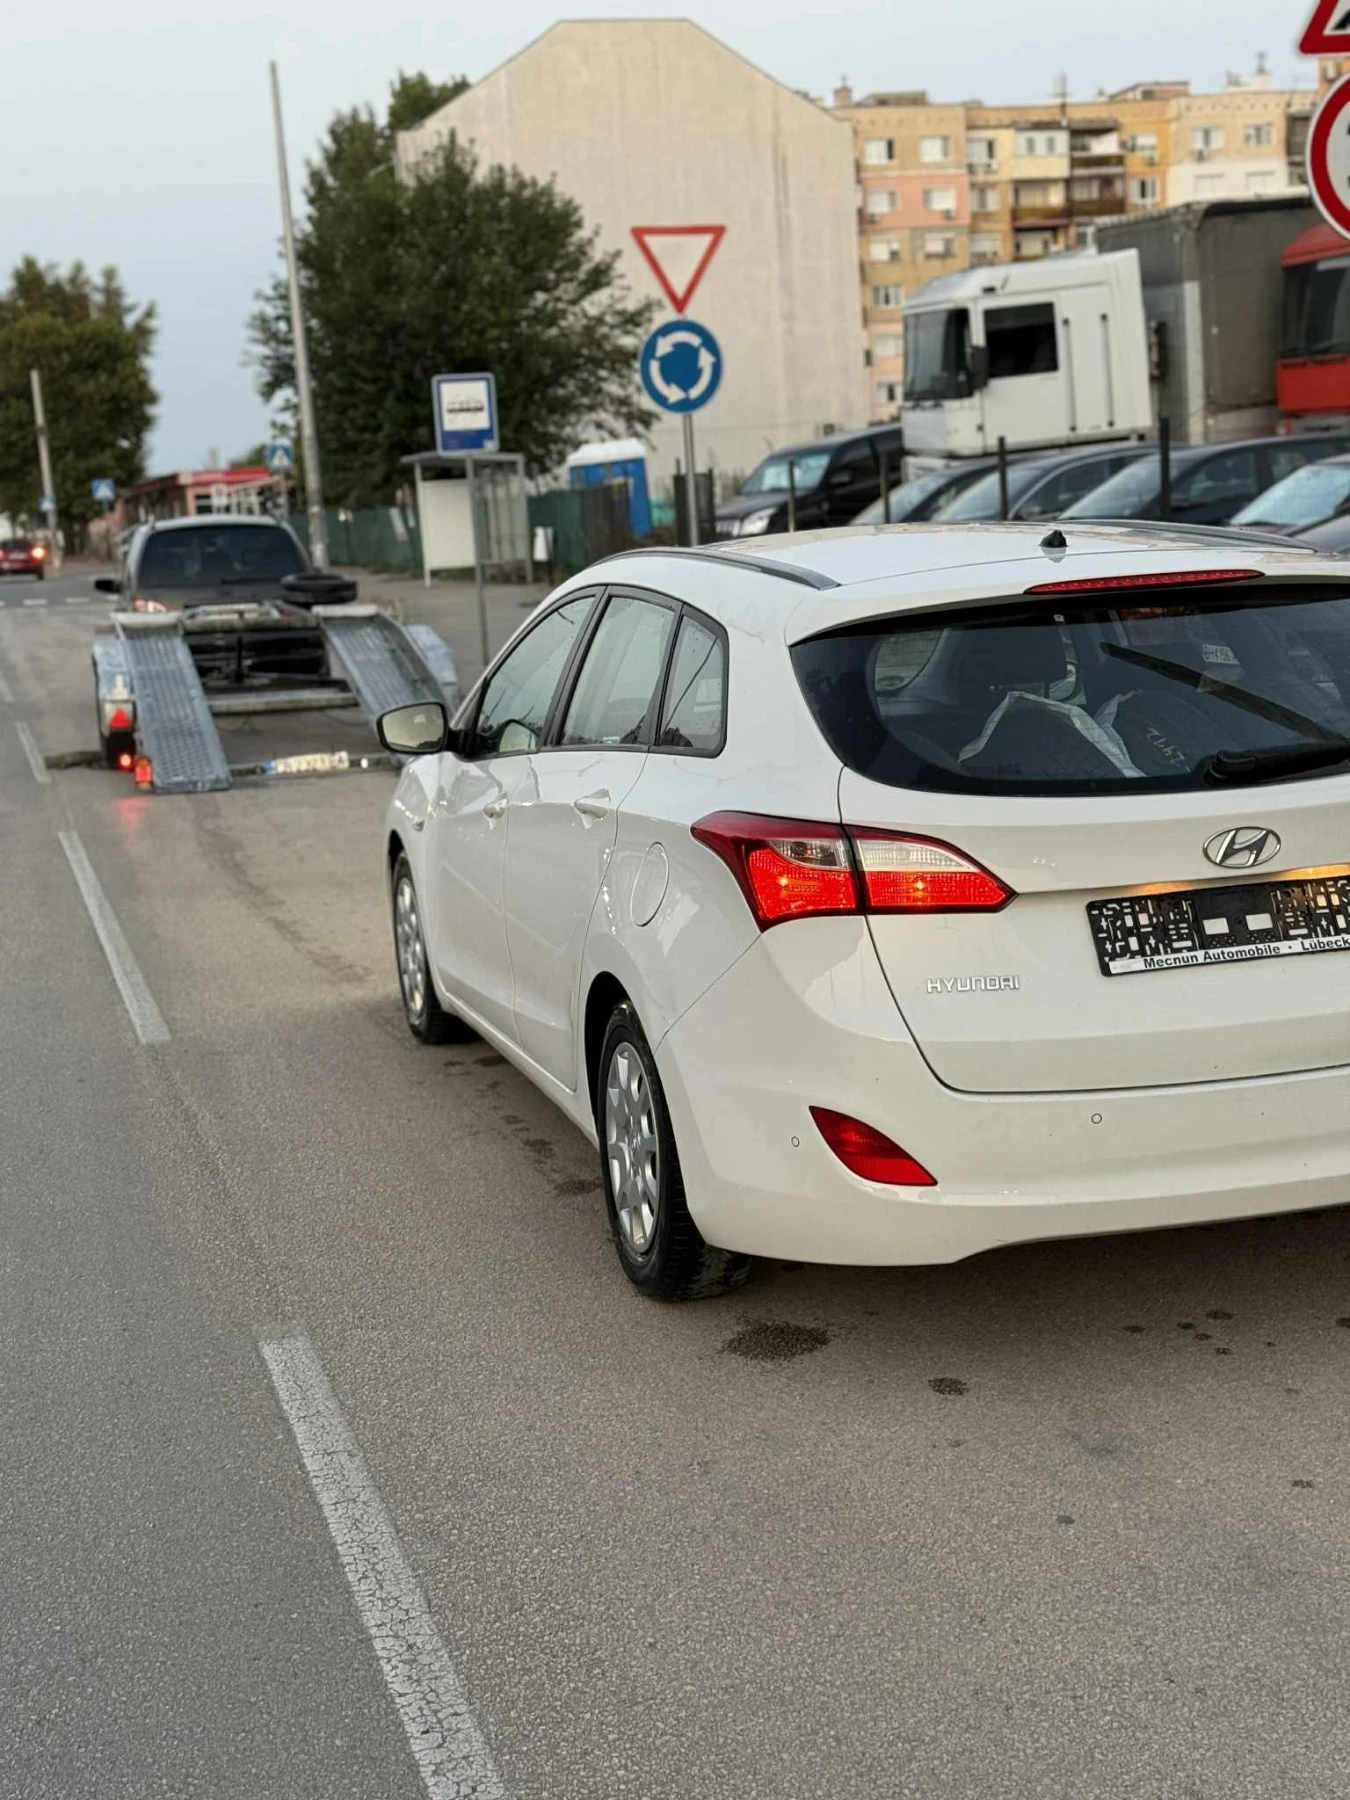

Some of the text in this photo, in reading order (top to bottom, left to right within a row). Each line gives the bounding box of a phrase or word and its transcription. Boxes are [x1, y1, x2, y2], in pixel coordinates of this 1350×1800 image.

[1143, 954, 1199, 970] Mecnun
[1203, 943, 1281, 963] Automobile
[1300, 936, 1350, 952] Lübeck
[926, 975, 1020, 994] HYUNDAI
